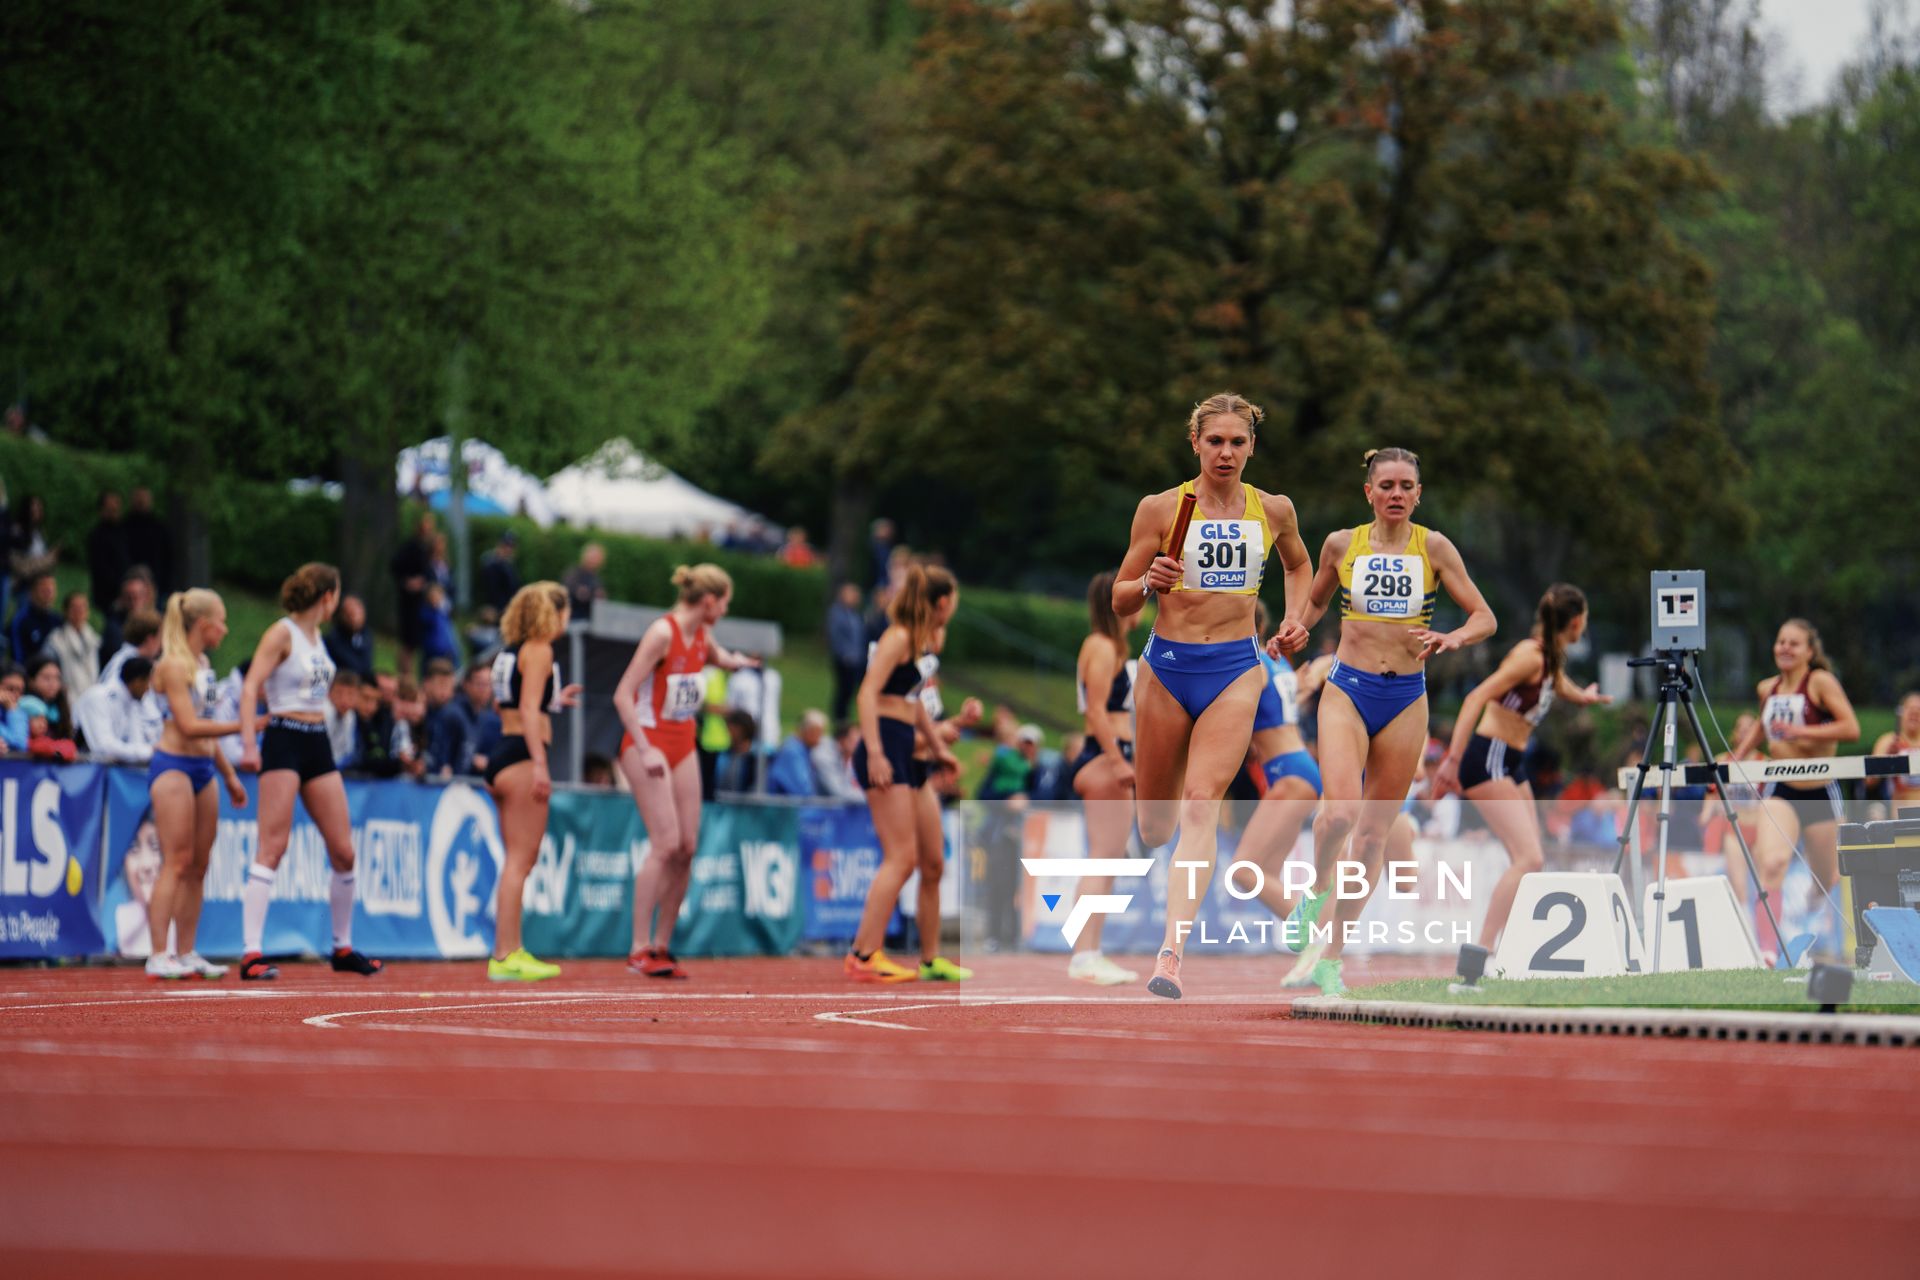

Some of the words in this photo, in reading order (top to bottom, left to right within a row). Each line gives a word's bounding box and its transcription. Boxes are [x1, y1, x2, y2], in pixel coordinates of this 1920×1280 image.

[1198, 542, 1247, 568] 301
[1219, 573, 1245, 582] PLAN
[1364, 573, 1412, 597] 298
[1383, 601, 1407, 609] PLAN
[1764, 763, 1830, 776] ERHARD
[0, 777, 83, 897] LS.
[1528, 891, 1587, 973] 2
[1667, 897, 1703, 969] 1
